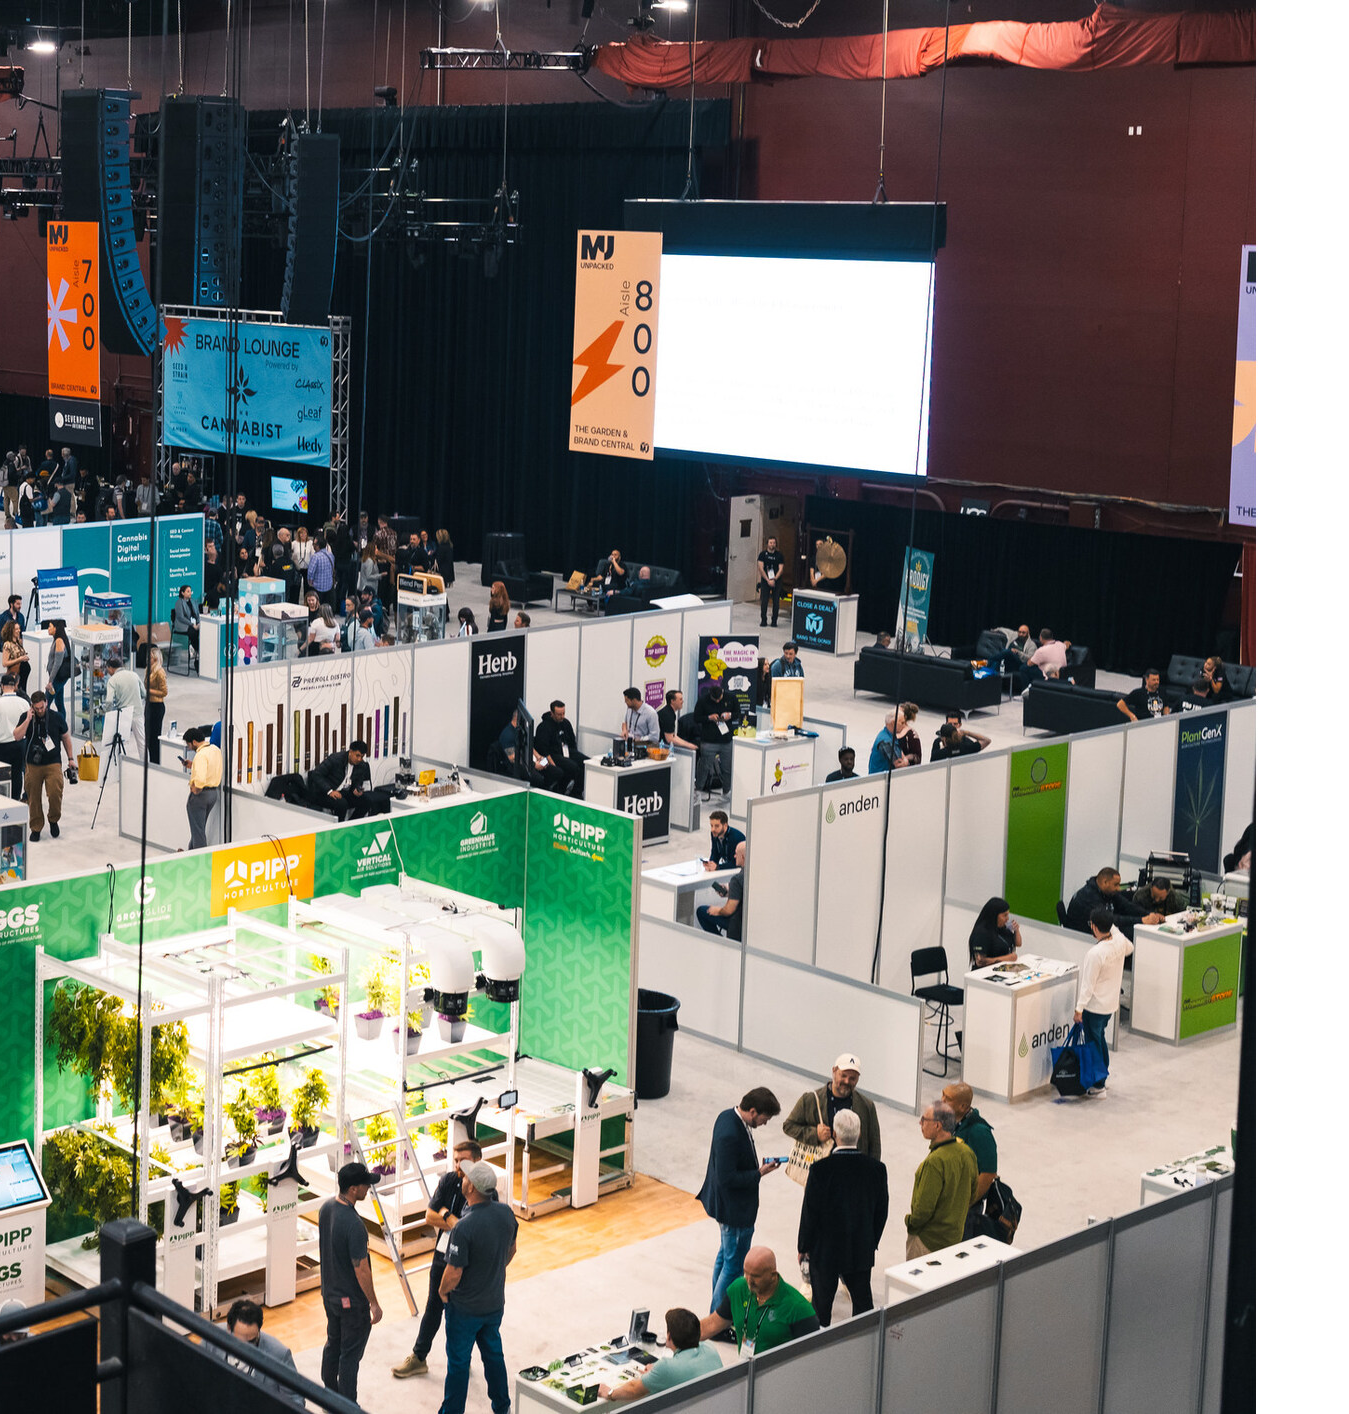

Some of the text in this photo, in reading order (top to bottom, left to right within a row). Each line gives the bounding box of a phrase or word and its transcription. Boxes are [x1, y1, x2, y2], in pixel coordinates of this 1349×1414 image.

[50, 224, 68, 244] MJ
[581, 235, 615, 261] MJ
[580, 262, 614, 271] UNPACKED
[82, 259, 94, 350] 700
[619, 280, 631, 316] Aisle
[196, 334, 300, 358] BRAND LOUNGE
[632, 280, 653, 397] 800
[265, 360, 298, 372] Powered by
[50, 382, 87, 393] BRAND CENTRAL
[201, 416, 282, 439] CANNABIST
[575, 425, 589, 433] THE
[590, 426, 621, 437] GARDEN
[298, 436, 323, 456] Hedy
[574, 436, 635, 451] BRAND CENTRAL
[117, 534, 148, 543] Cannabis
[117, 543, 140, 552] Digital
[117, 553, 150, 563] Marketing
[905, 568, 929, 589] PRODIGY
[478, 651, 516, 675] Herb
[330, 673, 351, 681] DISTRO
[1181, 724, 1222, 744] PlantGenX
[624, 791, 663, 815] Herb
[838, 794, 879, 818] anden
[460, 834, 495, 846] GREENHAUS
[570, 821, 606, 843] PIPP
[460, 840, 495, 852] INDUSTRIES
[553, 833, 605, 853] HORTICULTURE
[250, 854, 301, 883] PIPP
[357, 853, 391, 867] VERTICAL
[365, 860, 391, 871] SOLUTIONS
[224, 878, 298, 901] HORTICULTURE
[1032, 1022, 1070, 1049] anden
[280, 1201, 296, 1211] PIPP
[178, 1231, 194, 1240] PIPP
